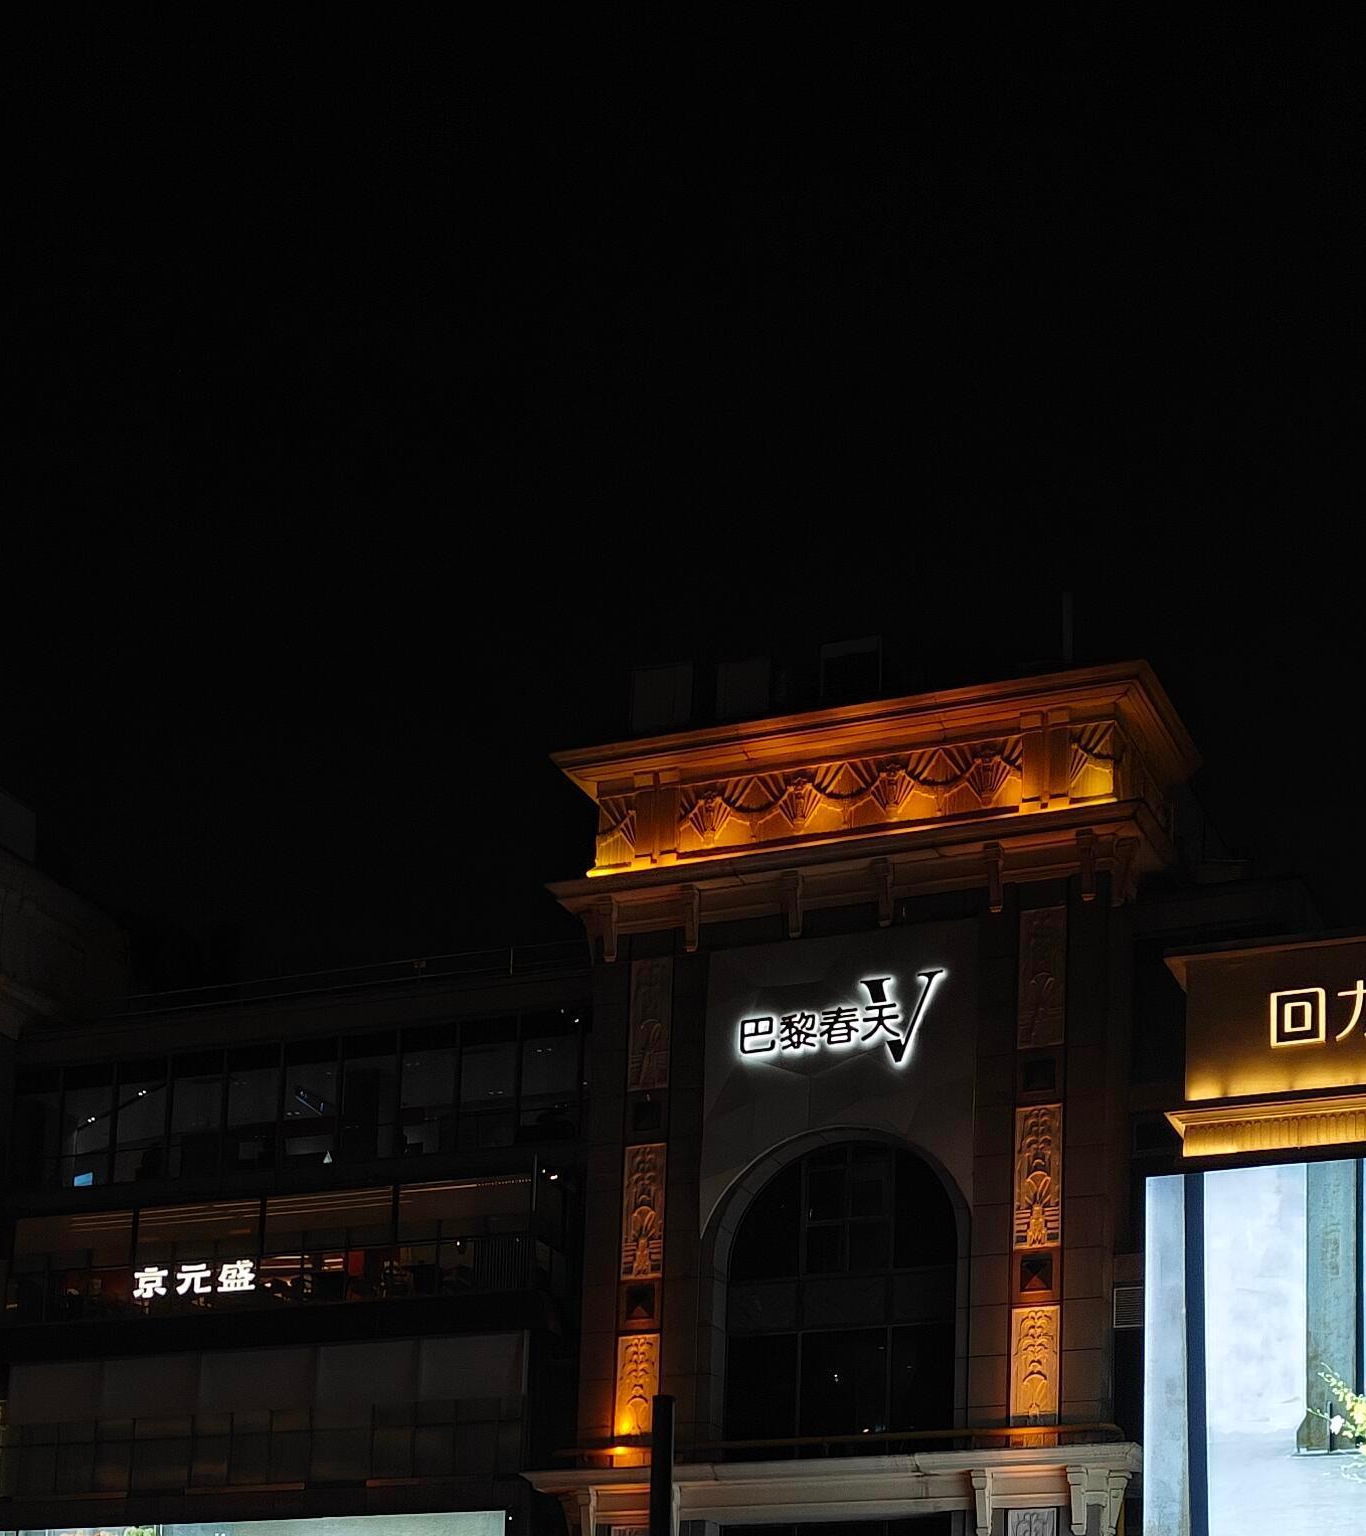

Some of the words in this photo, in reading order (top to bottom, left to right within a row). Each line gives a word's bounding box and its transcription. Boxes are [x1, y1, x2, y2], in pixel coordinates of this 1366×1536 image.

[739, 1003, 901, 1055] 巴黎春天
[132, 1259, 256, 1299] 京元盛
